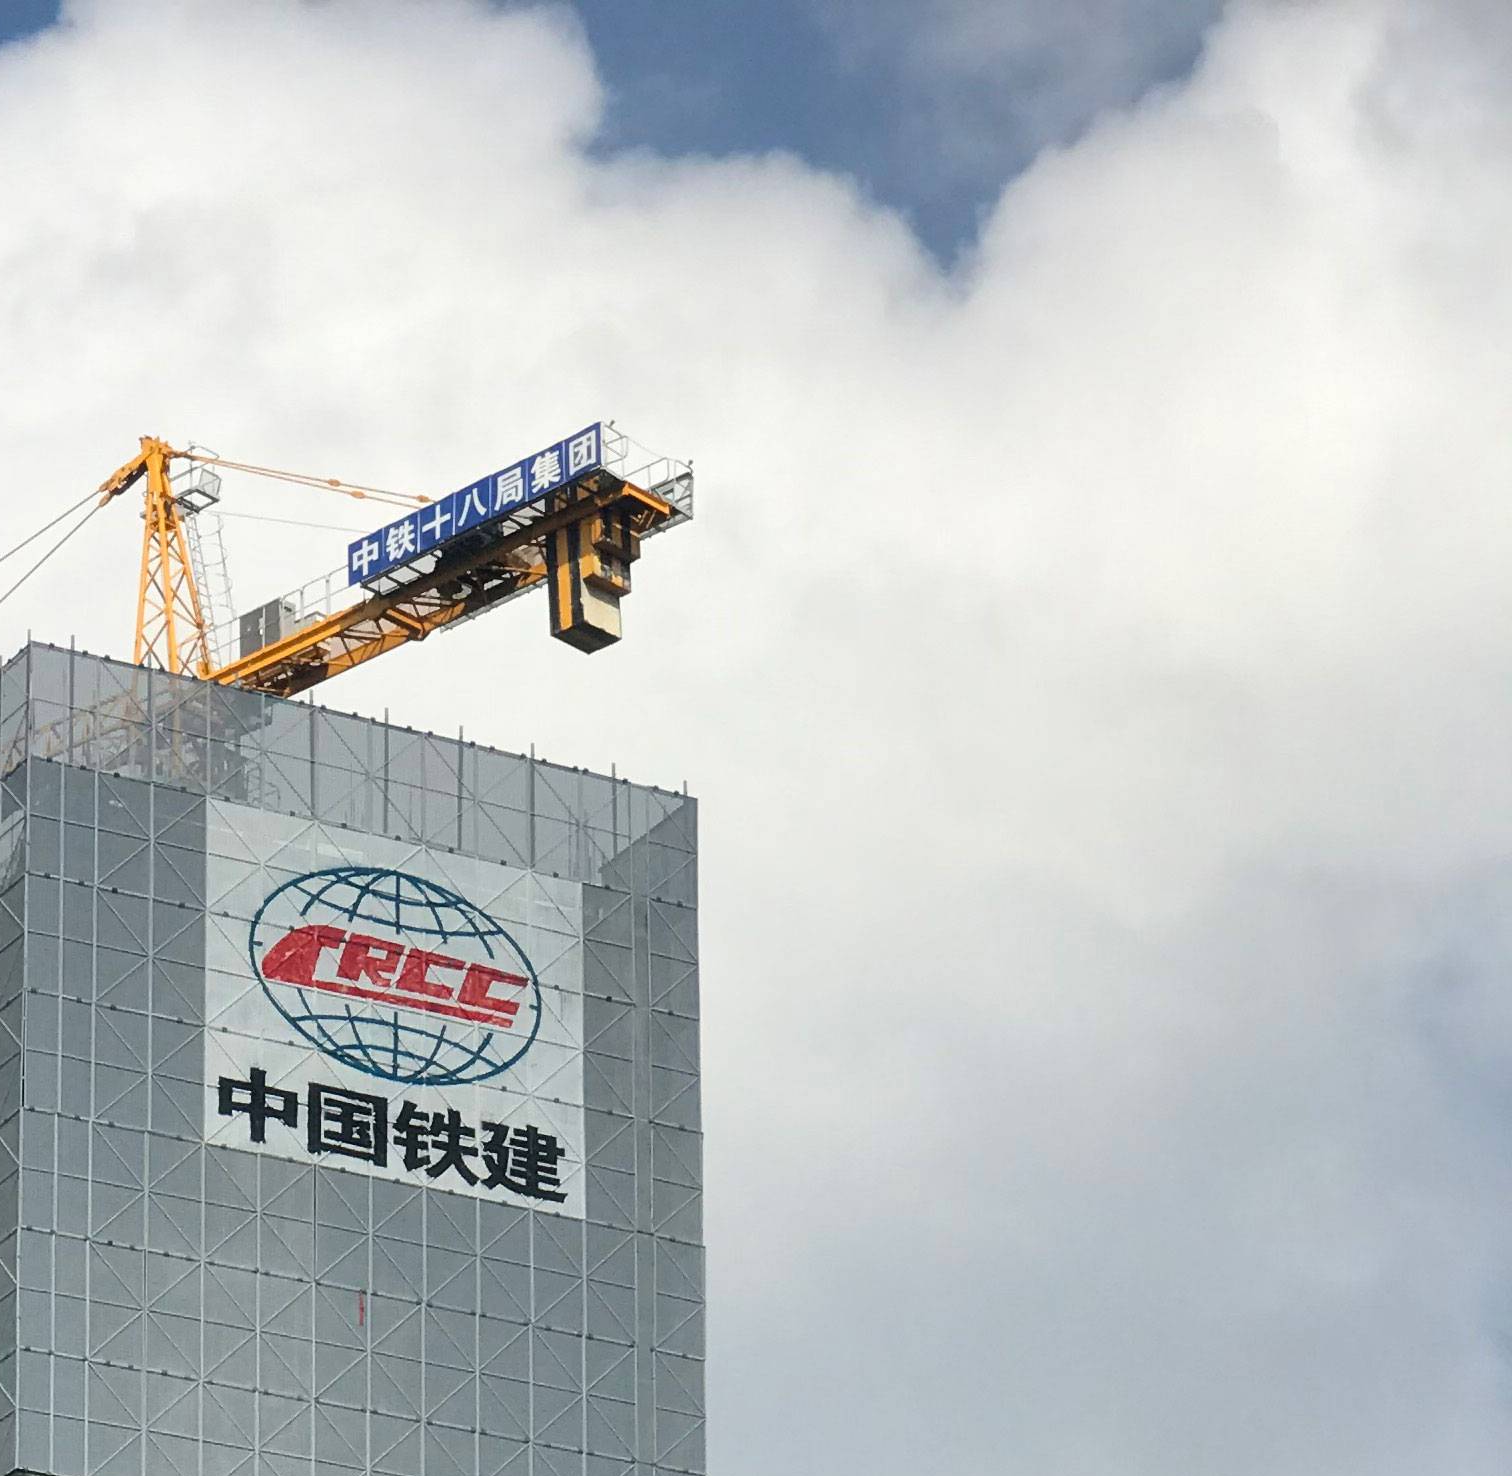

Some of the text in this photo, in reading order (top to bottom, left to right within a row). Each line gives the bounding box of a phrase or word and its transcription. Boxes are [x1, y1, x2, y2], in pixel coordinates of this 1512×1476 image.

[352, 429, 597, 577] 中铁十八局集团
[261, 925, 529, 1028] CRCC
[218, 1067, 567, 1203] 中国铁建
